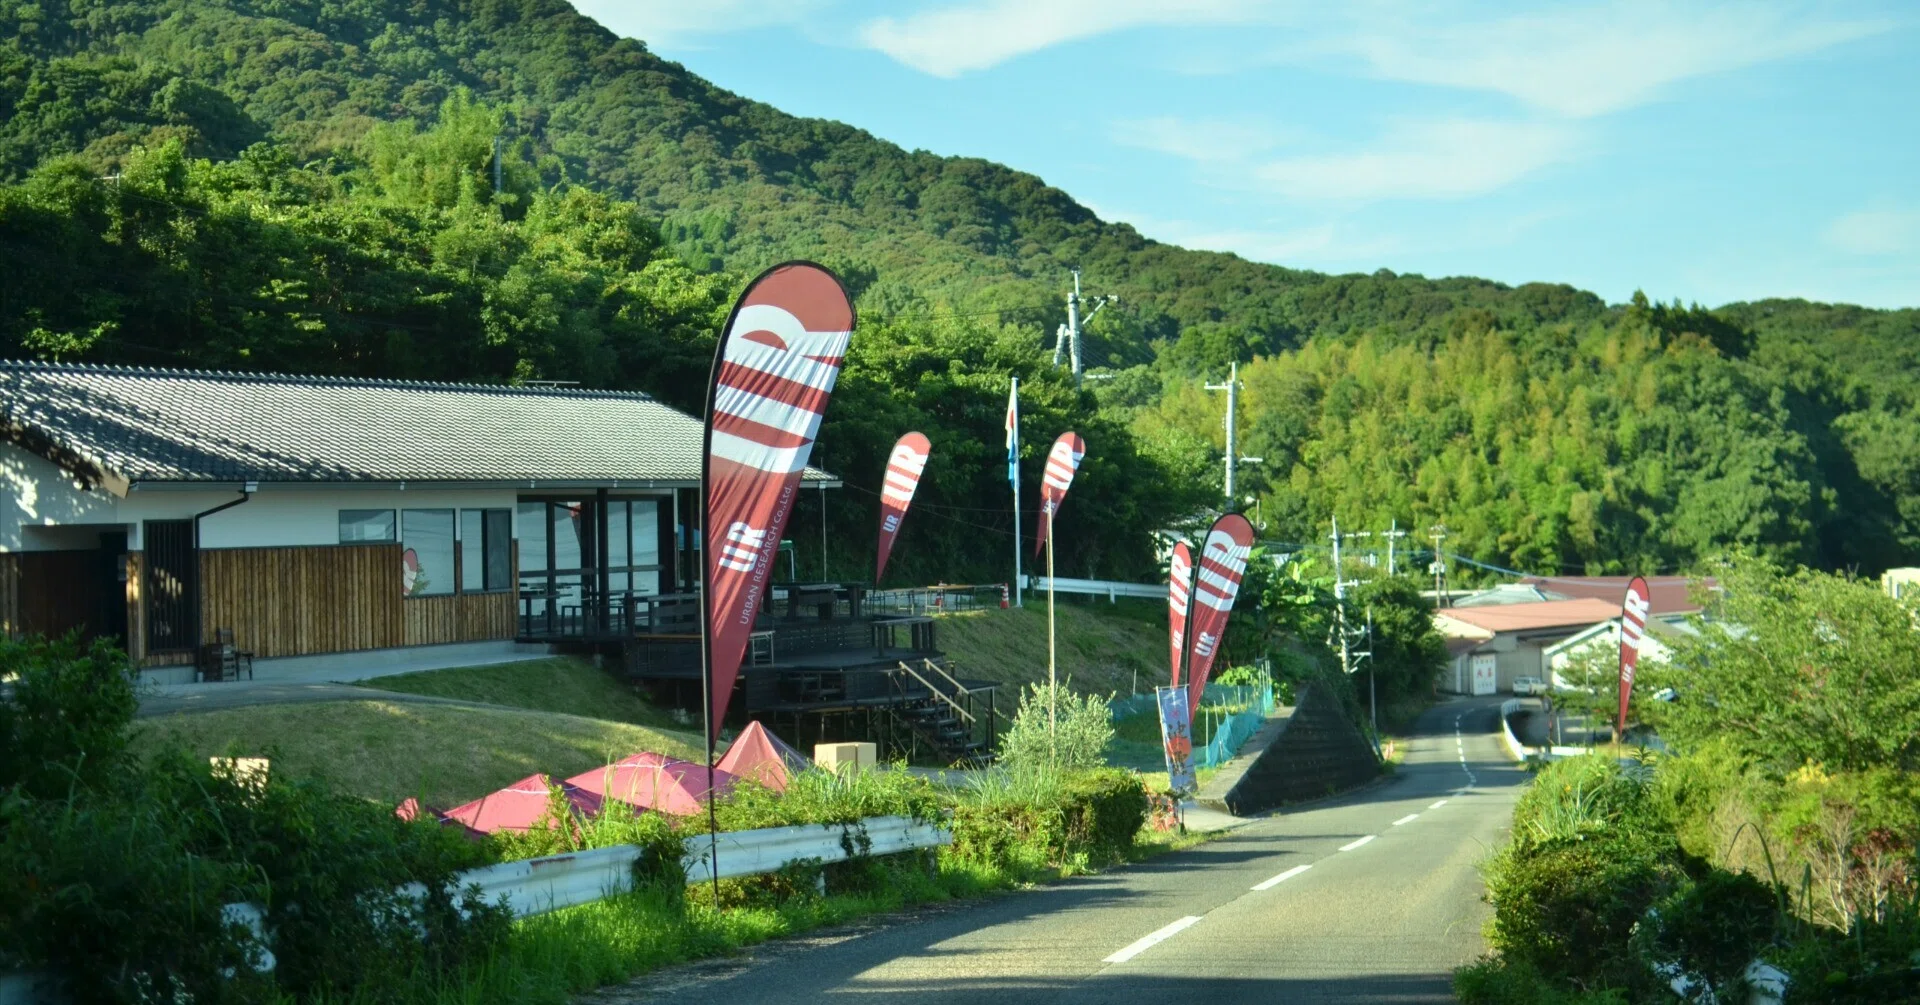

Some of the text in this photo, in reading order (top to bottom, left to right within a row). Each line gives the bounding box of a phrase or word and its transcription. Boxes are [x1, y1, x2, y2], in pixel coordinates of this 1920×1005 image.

[711, 304, 853, 473] UR
[883, 445, 929, 502] UR
[1043, 441, 1085, 490] UR
[719, 521, 767, 573] UR
[882, 514, 899, 533] UR
[740, 585, 759, 625] URBAN
[753, 526, 779, 583] RESEARCH
[1170, 554, 1192, 616] UR
[1195, 530, 1251, 611] UR
[1195, 631, 1216, 657] UR
[1621, 589, 1649, 650] UR
